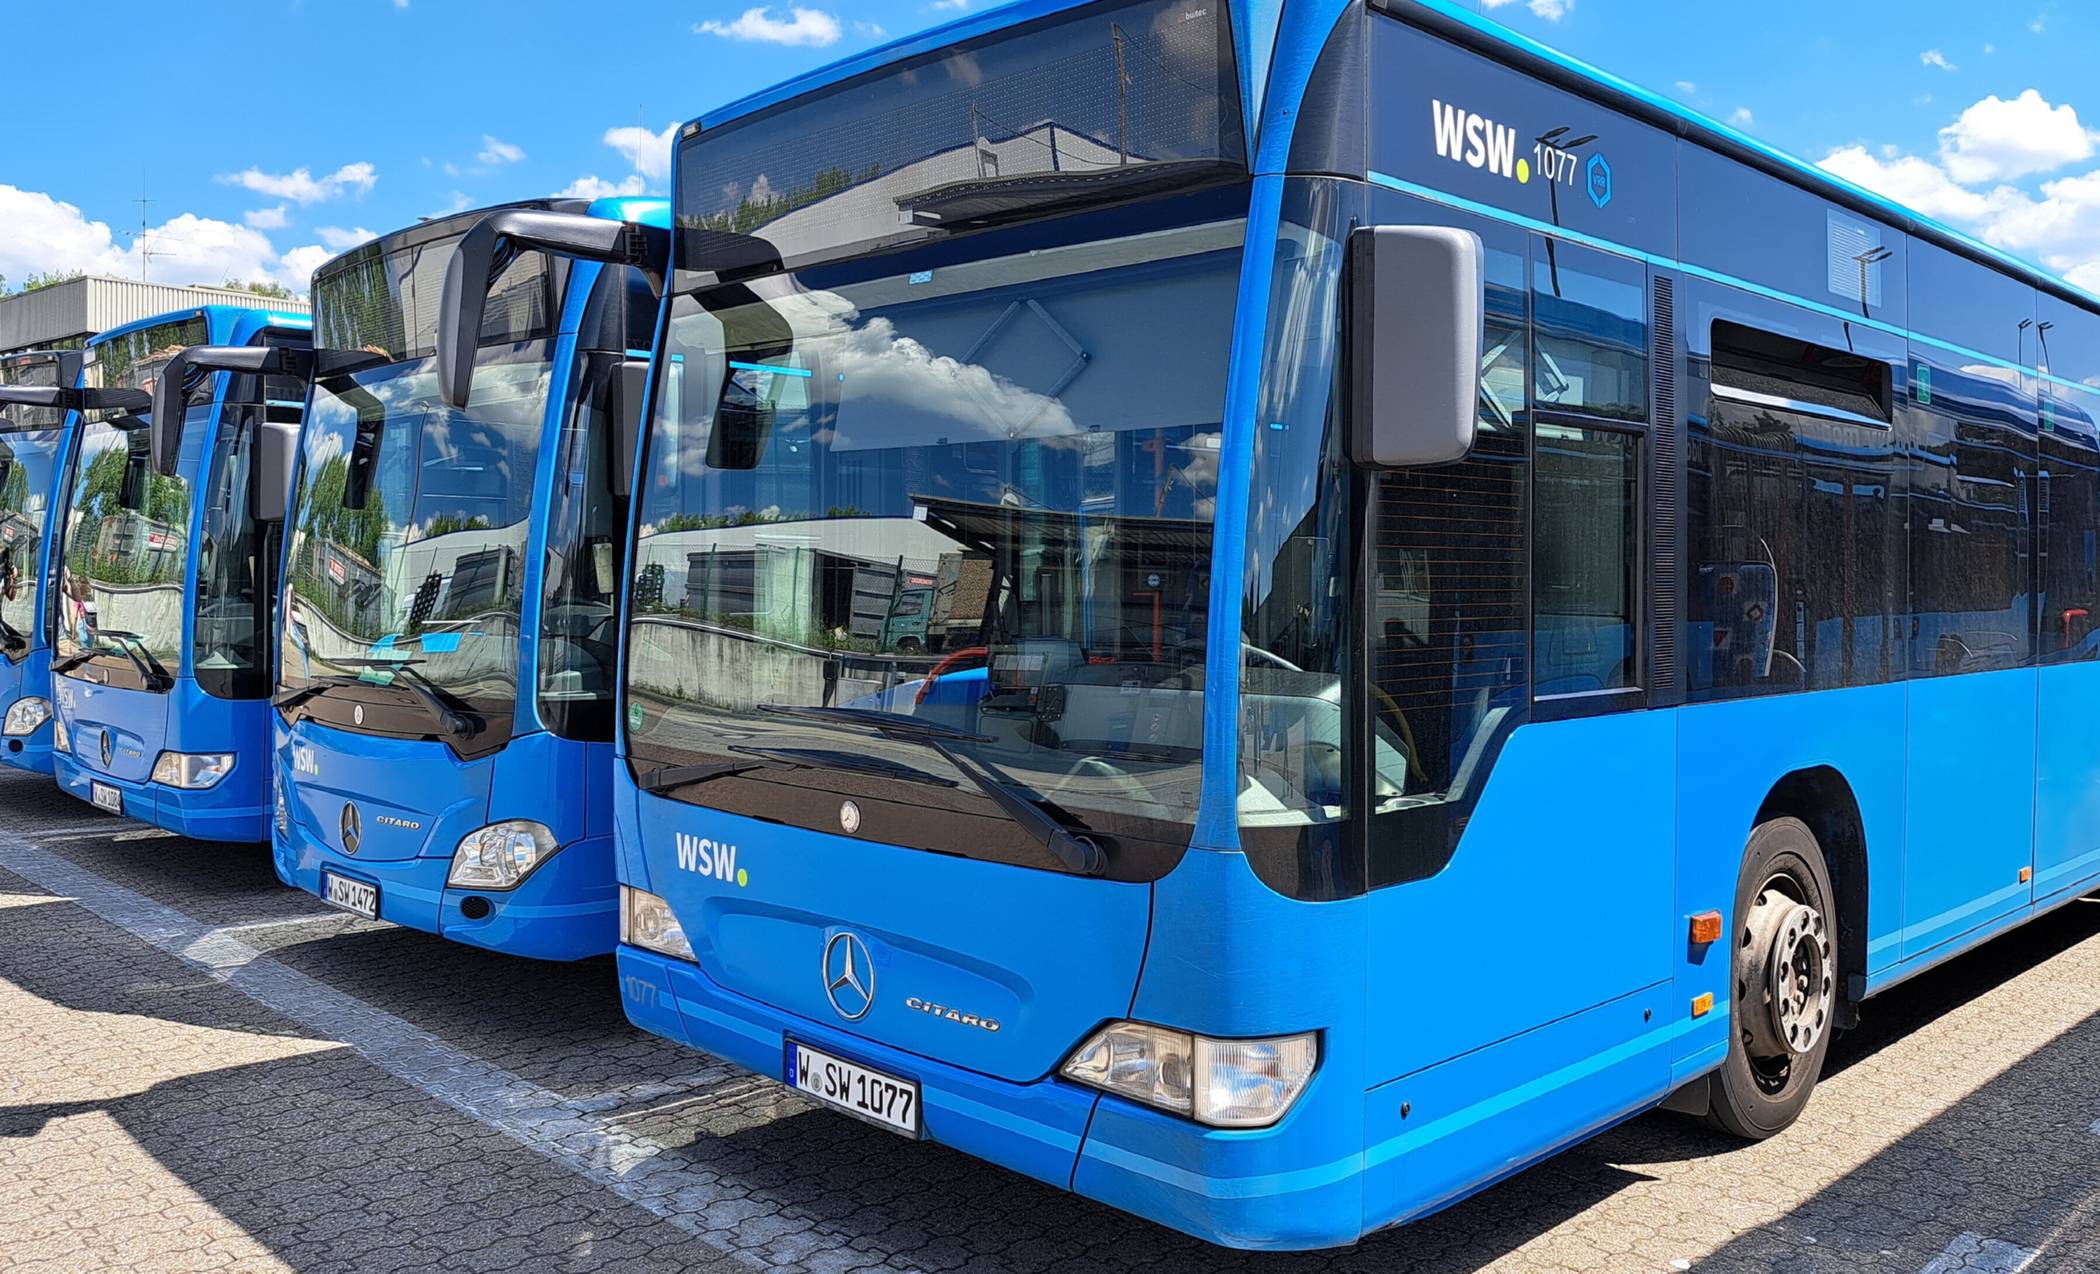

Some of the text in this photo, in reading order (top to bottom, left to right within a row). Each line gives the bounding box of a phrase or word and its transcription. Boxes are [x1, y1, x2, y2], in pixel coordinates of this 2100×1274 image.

[1533, 143, 1578, 186] 1077
[376, 815, 422, 830] CITARO
[328, 877, 376, 913] W SW 1472
[625, 975, 657, 1009] 1077
[904, 996, 1001, 1032] CITARO
[798, 1051, 810, 1087] W
[824, 1062, 851, 1103] SW
[857, 1074, 914, 1124] 1077
